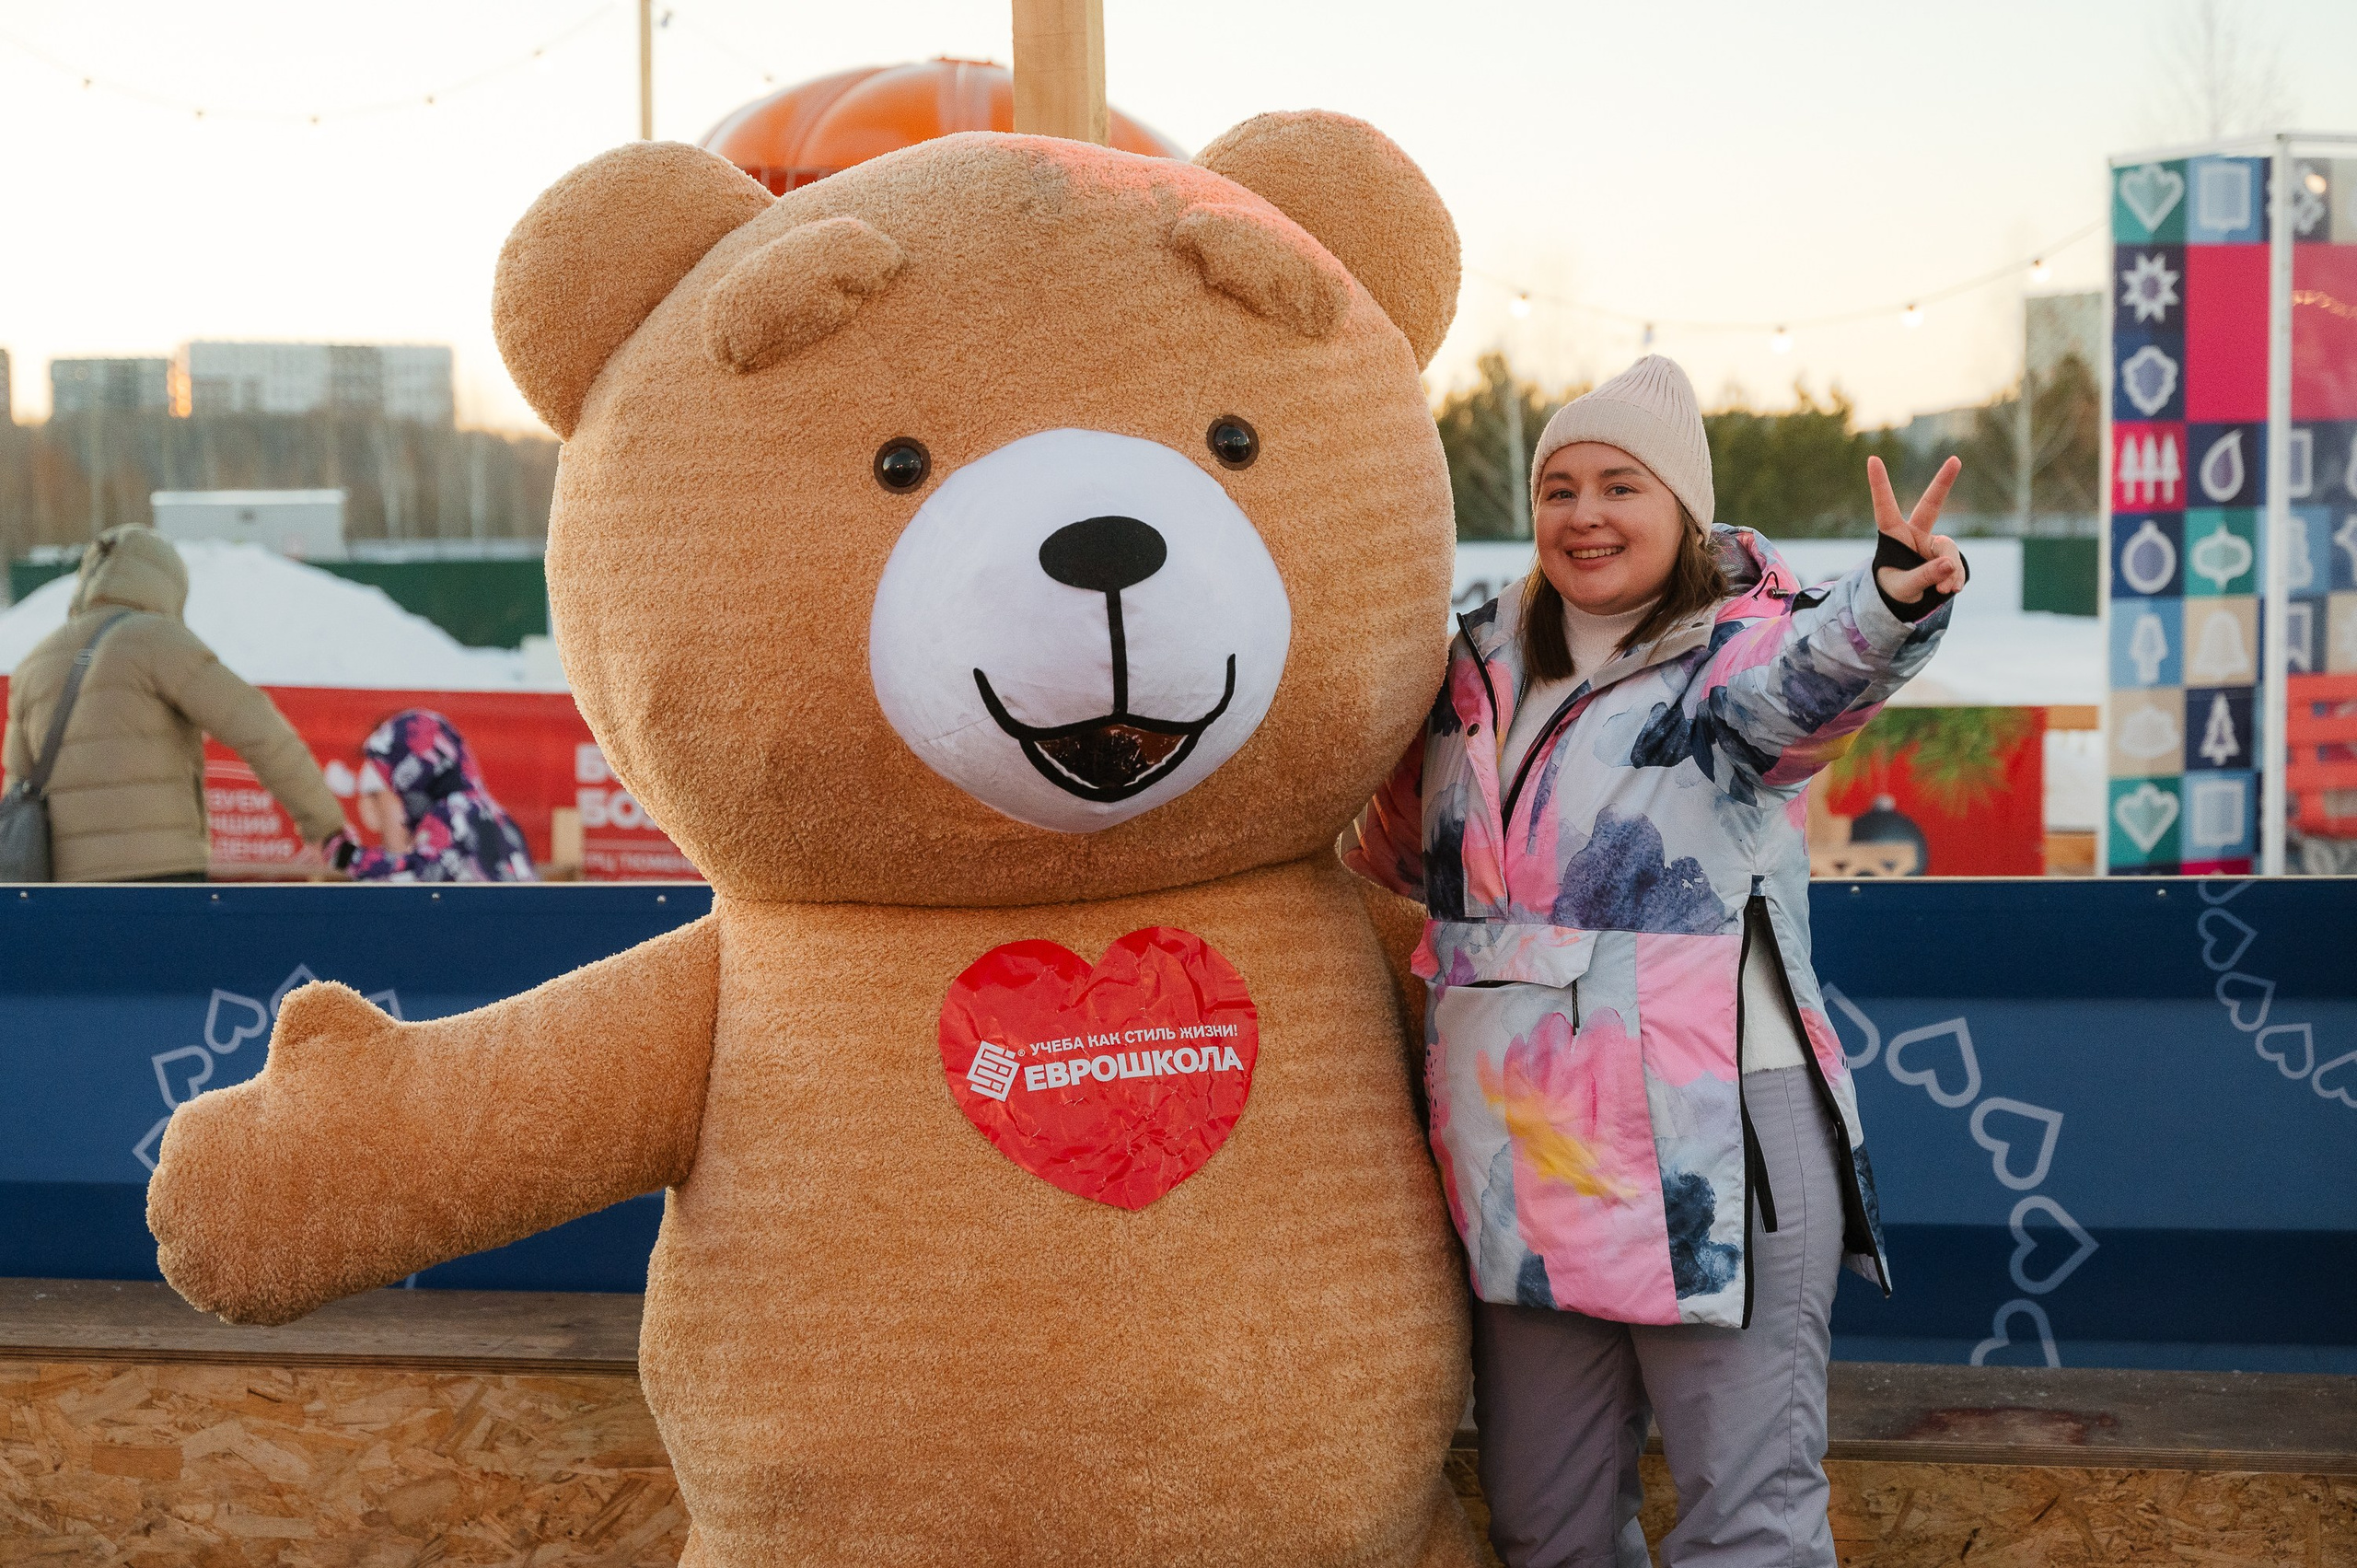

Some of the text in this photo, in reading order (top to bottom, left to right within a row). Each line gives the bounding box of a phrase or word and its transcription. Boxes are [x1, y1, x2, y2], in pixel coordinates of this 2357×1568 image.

[575, 788, 660, 830] БО
[1029, 1024, 1238, 1056] УЧЕБА КАК СТИЛЬ ЖИЗНИ!
[1023, 1046, 1245, 1092] ЕВРОШКОЛА
